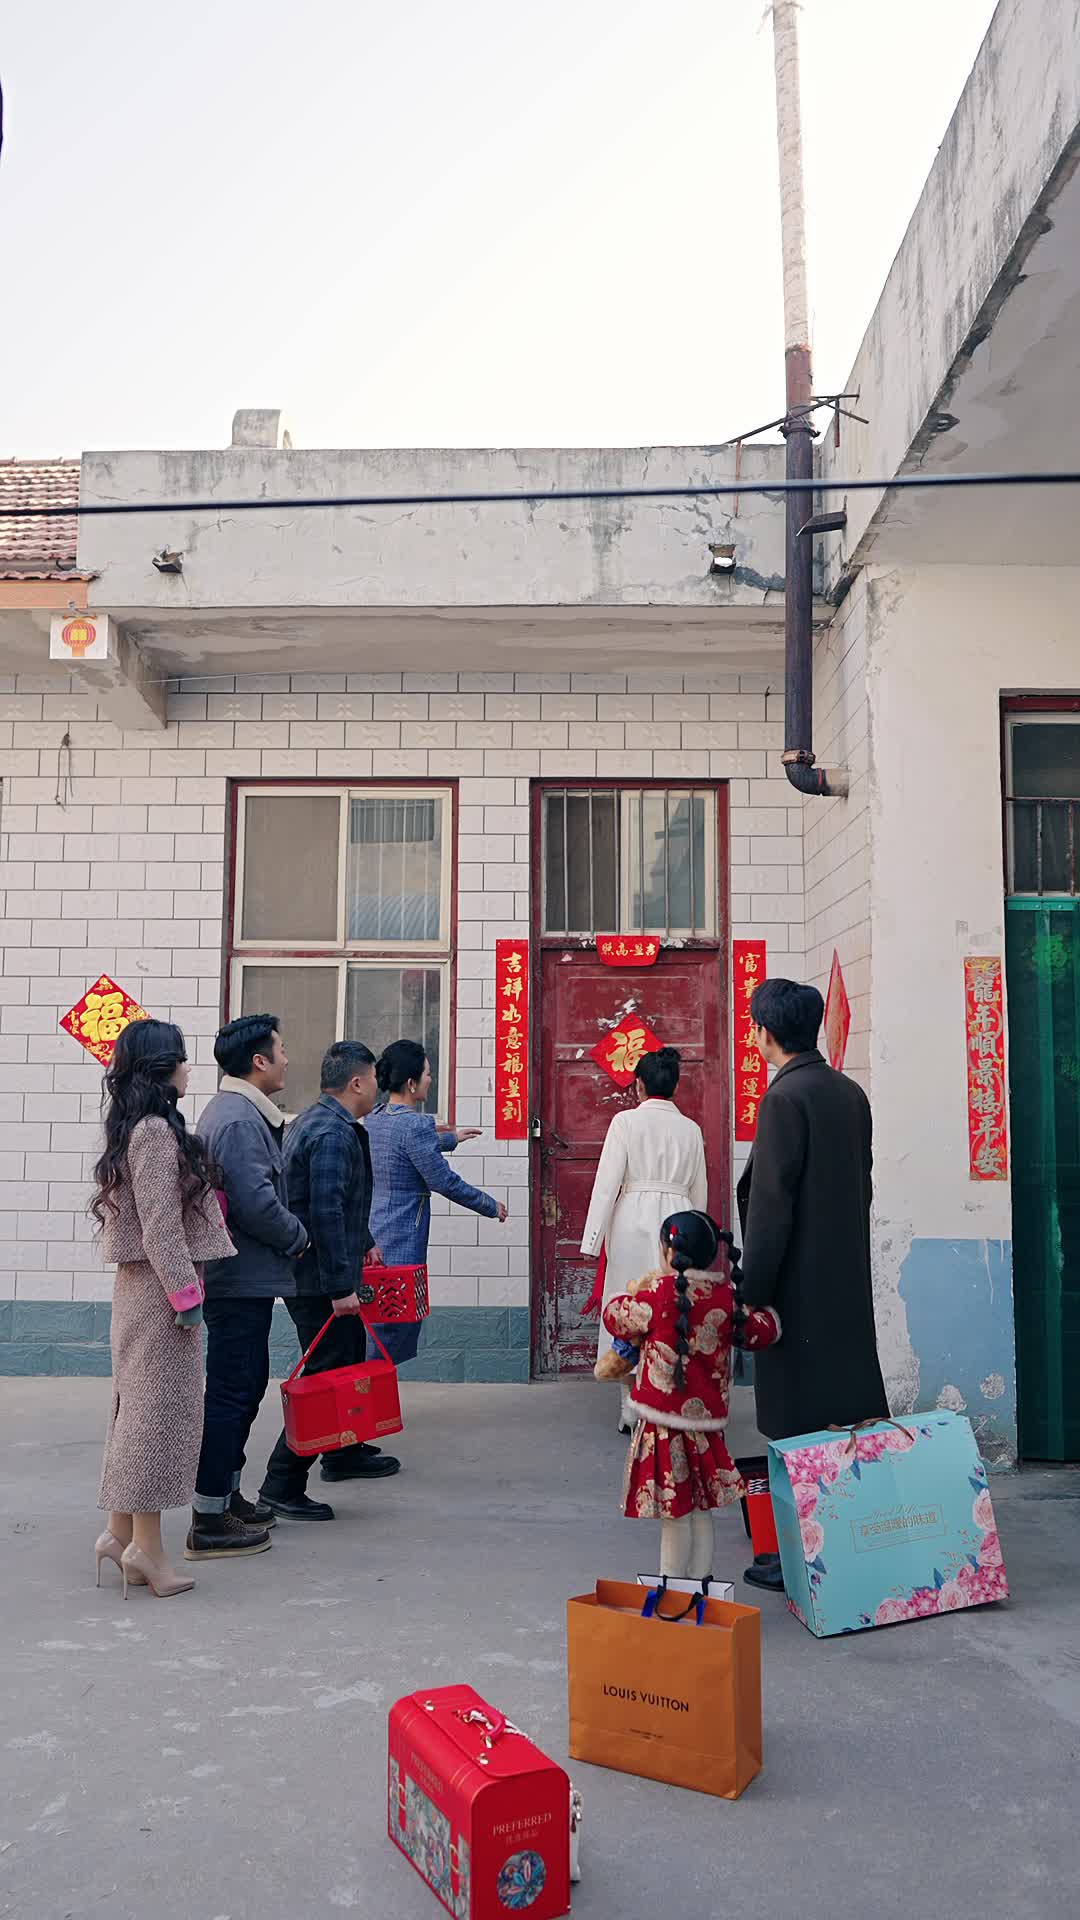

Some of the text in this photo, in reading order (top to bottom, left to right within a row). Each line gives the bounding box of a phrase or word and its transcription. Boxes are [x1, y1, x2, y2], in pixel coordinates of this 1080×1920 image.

[80, 992, 130, 1044] 福
[499, 952, 524, 1123] 吉祥如意福星到
[606, 1028, 648, 1072] 福
[603, 1684, 689, 1712] LOUIS VUITTON
[493, 1812, 552, 1837] PREFERRED
